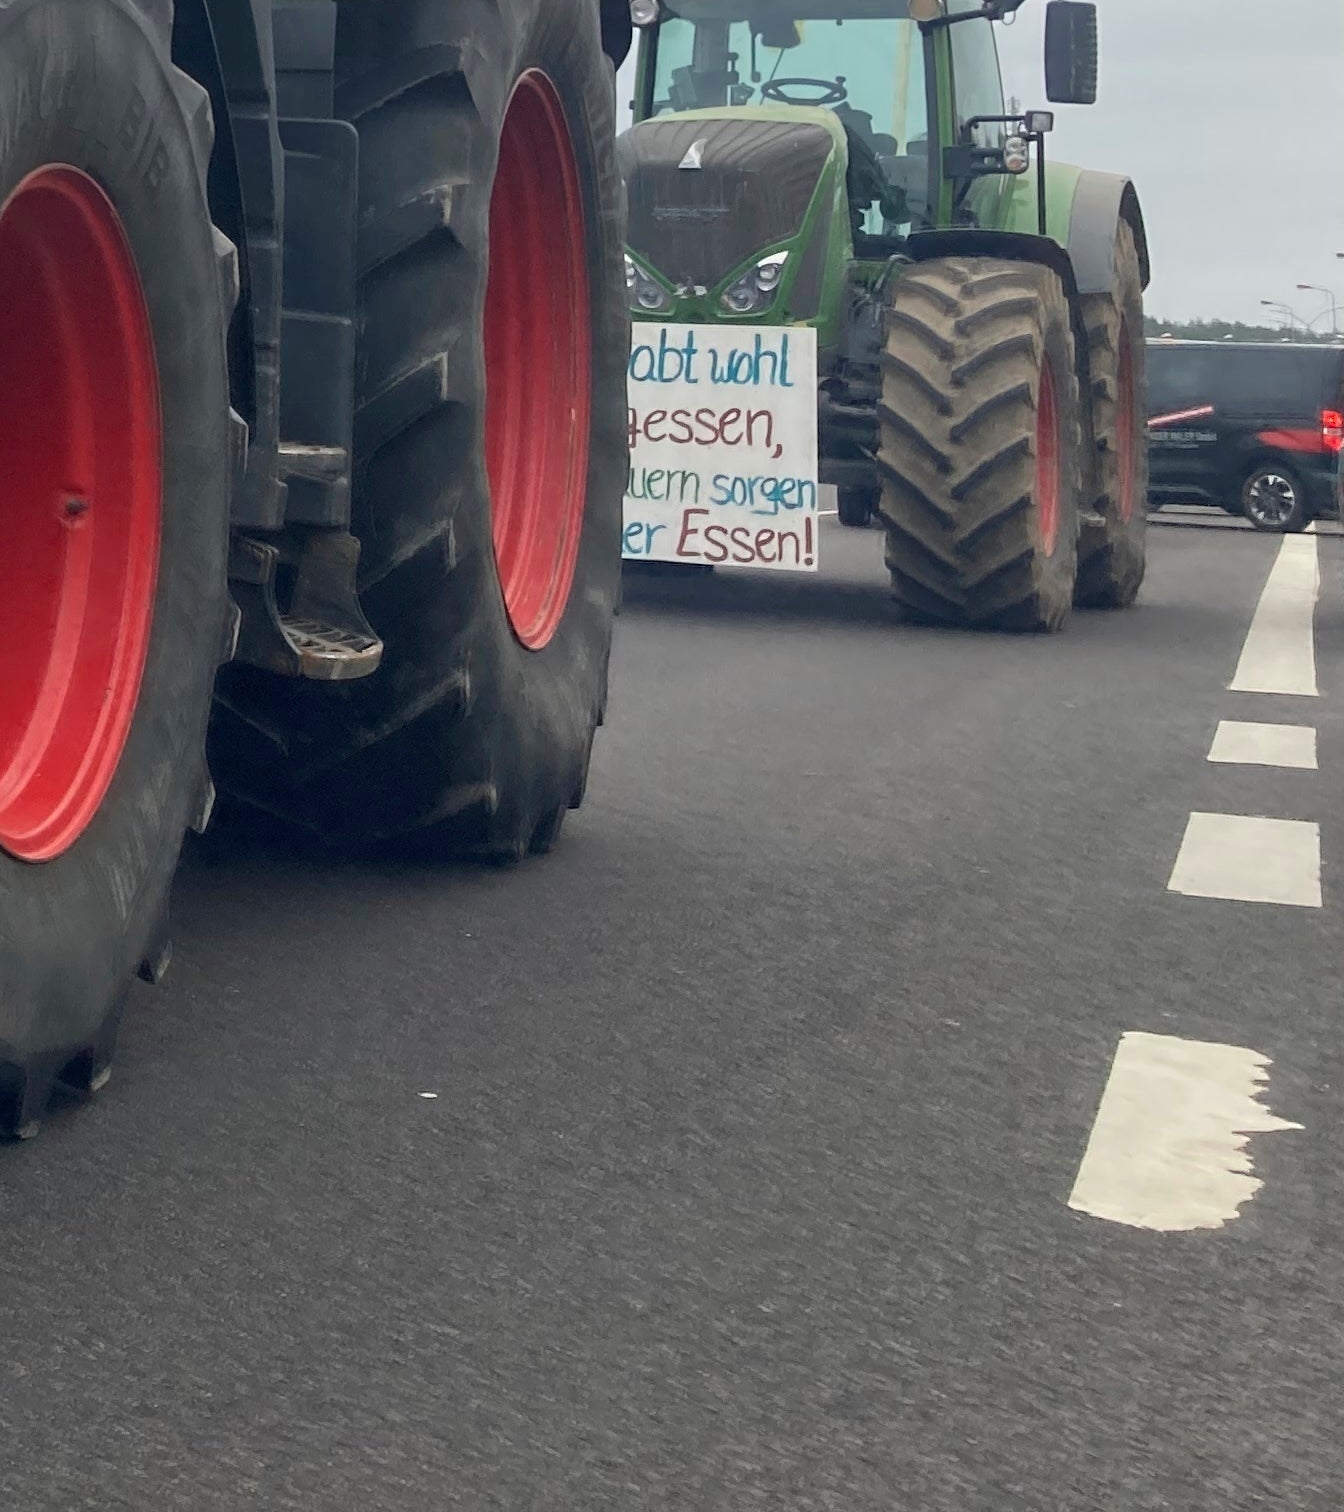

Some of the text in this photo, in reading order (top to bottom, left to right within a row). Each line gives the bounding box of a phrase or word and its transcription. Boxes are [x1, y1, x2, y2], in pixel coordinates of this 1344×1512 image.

[629, 328, 794, 387] abt wohl
[626, 467, 816, 516] uern sorgen
[623, 508, 814, 566] er Essen!
